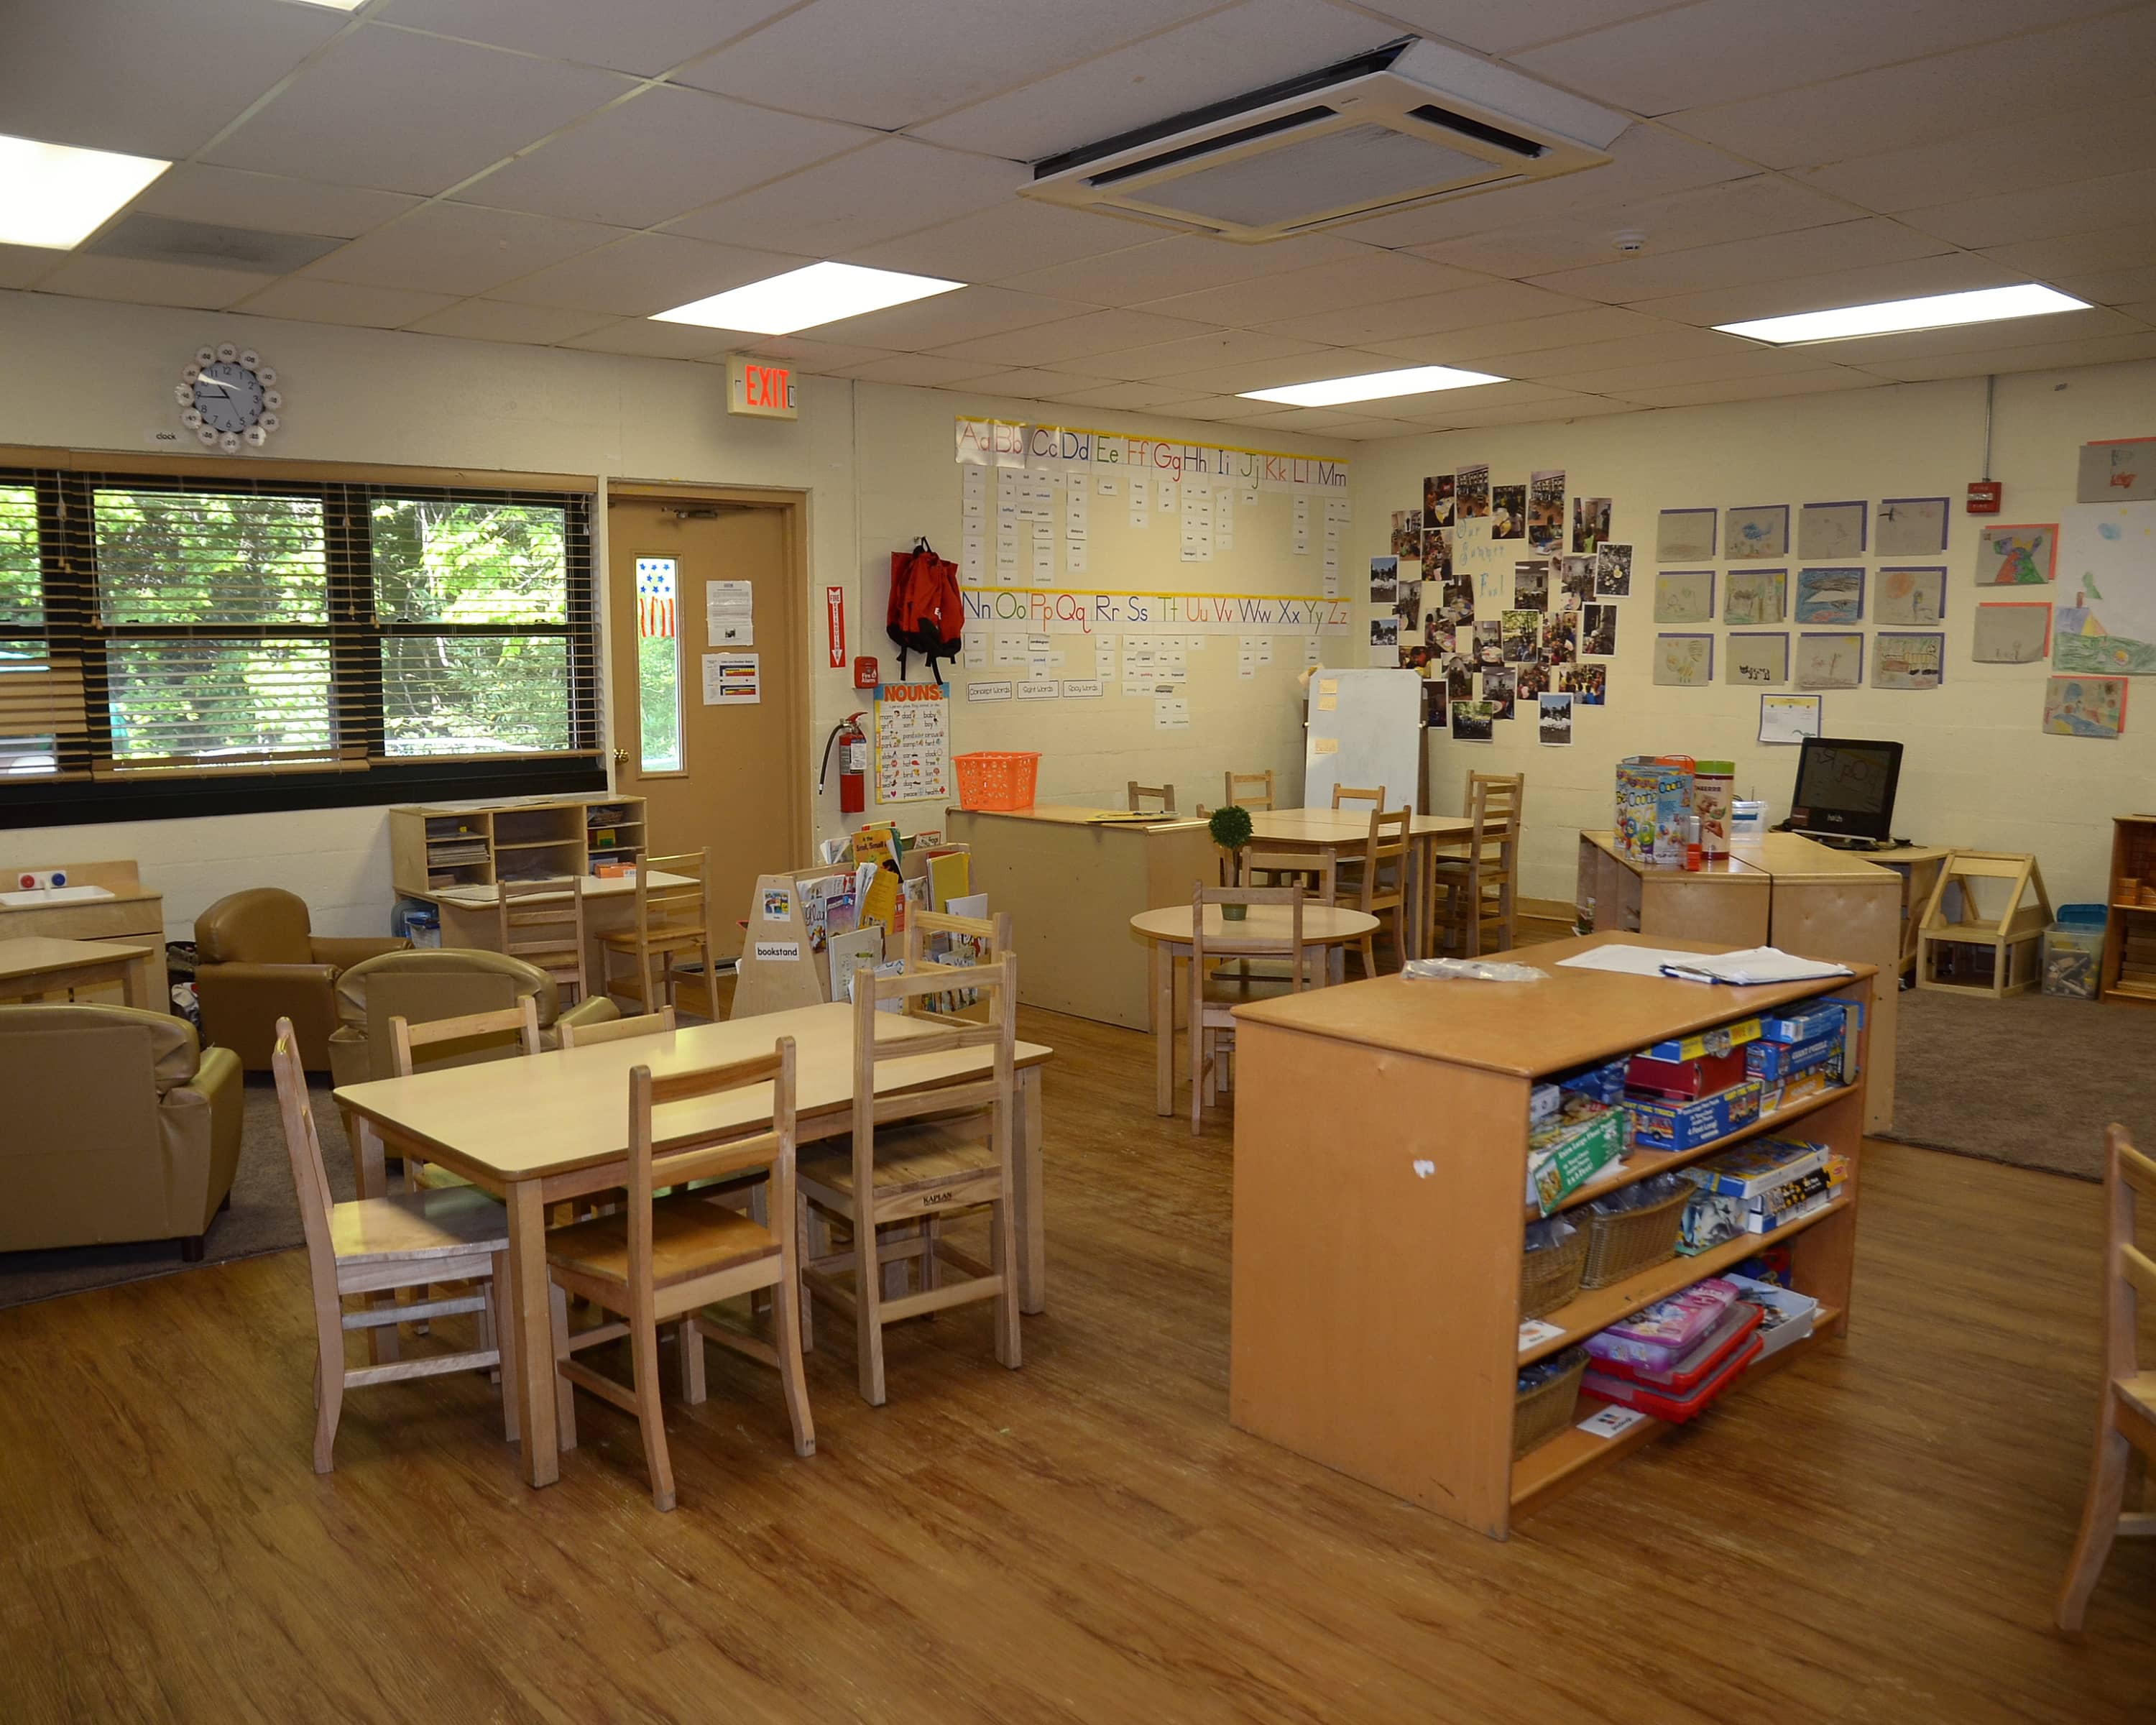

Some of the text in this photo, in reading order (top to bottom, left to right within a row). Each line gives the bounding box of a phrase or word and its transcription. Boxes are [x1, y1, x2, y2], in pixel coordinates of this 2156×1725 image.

[211, 369, 218, 378] 11
[223, 367, 231, 375] 12
[746, 364, 789, 410] EXIT
[959, 423, 1347, 489] Aa Bb Cc Dd Ee Ff Gg Hh Ii Jj Kk Ll Mm
[1457, 518, 1480, 539] Our
[962, 591, 991, 620] Nn
[995, 592, 1026, 620] Oo
[1031, 593, 1054, 632] Pp
[1056, 594, 1092, 634] Qq
[1096, 595, 1120, 622] Rr
[1127, 596, 1148, 622] Ss
[1158, 597, 1179, 622] Tt
[1187, 598, 1208, 622] Uu
[1213, 598, 1233, 622] Vv
[1238, 599, 1271, 623] Ww
[1278, 600, 1300, 624] Xx
[1304, 601, 1323, 635] Yy
[1327, 601, 1348, 625] Zz
[884, 684, 944, 702] NOUNS:
[969, 686, 1010, 696] Concept Words
[1082, 684, 1098, 693] Words
[923, 710, 936, 719] baby
[923, 720, 933, 730] boy
[903, 732, 915, 740] pond
[870, 841, 884, 850] Small
[757, 947, 798, 957] bookstand
